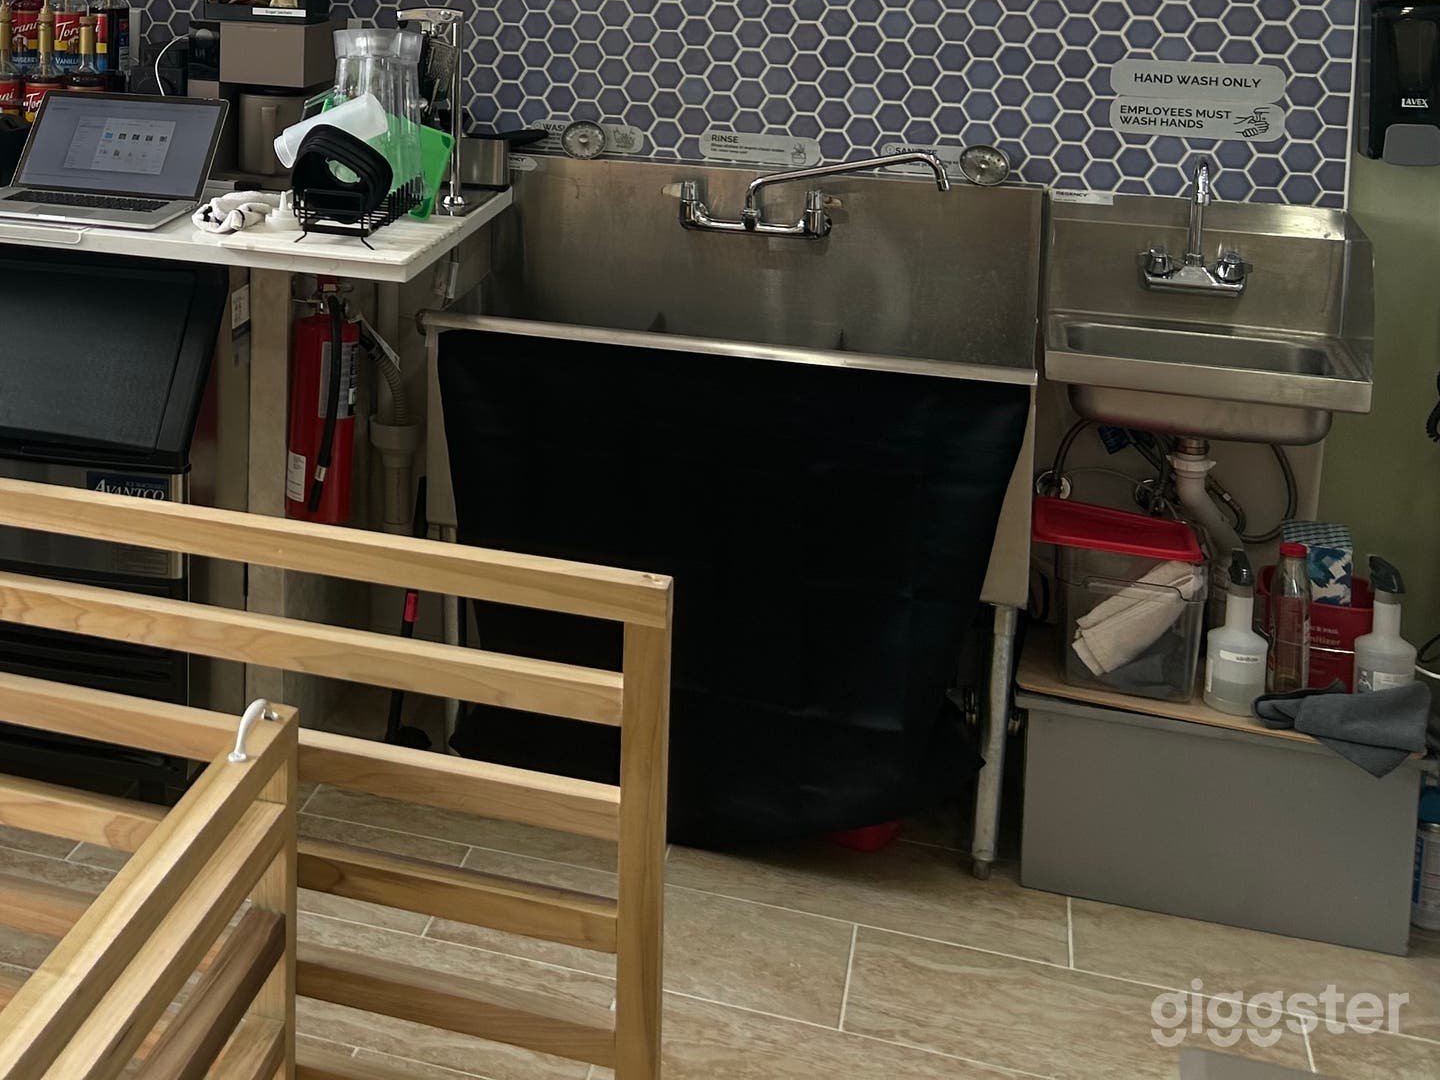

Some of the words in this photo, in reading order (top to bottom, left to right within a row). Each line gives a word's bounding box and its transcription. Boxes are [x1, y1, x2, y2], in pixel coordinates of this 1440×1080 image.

[1134, 72, 1173, 85] HAND
[1177, 74, 1219, 87] WASH
[1223, 77, 1262, 88] ONLY
[1401, 97, 1429, 108] LAVEX
[1120, 104, 1193, 118] EMPLOYEES
[1196, 109, 1232, 120] MUST
[542, 123, 565, 132] WAS
[1120, 115, 1157, 128] WASH
[1160, 117, 1204, 129] HANDS
[711, 134, 739, 143] RINSE
